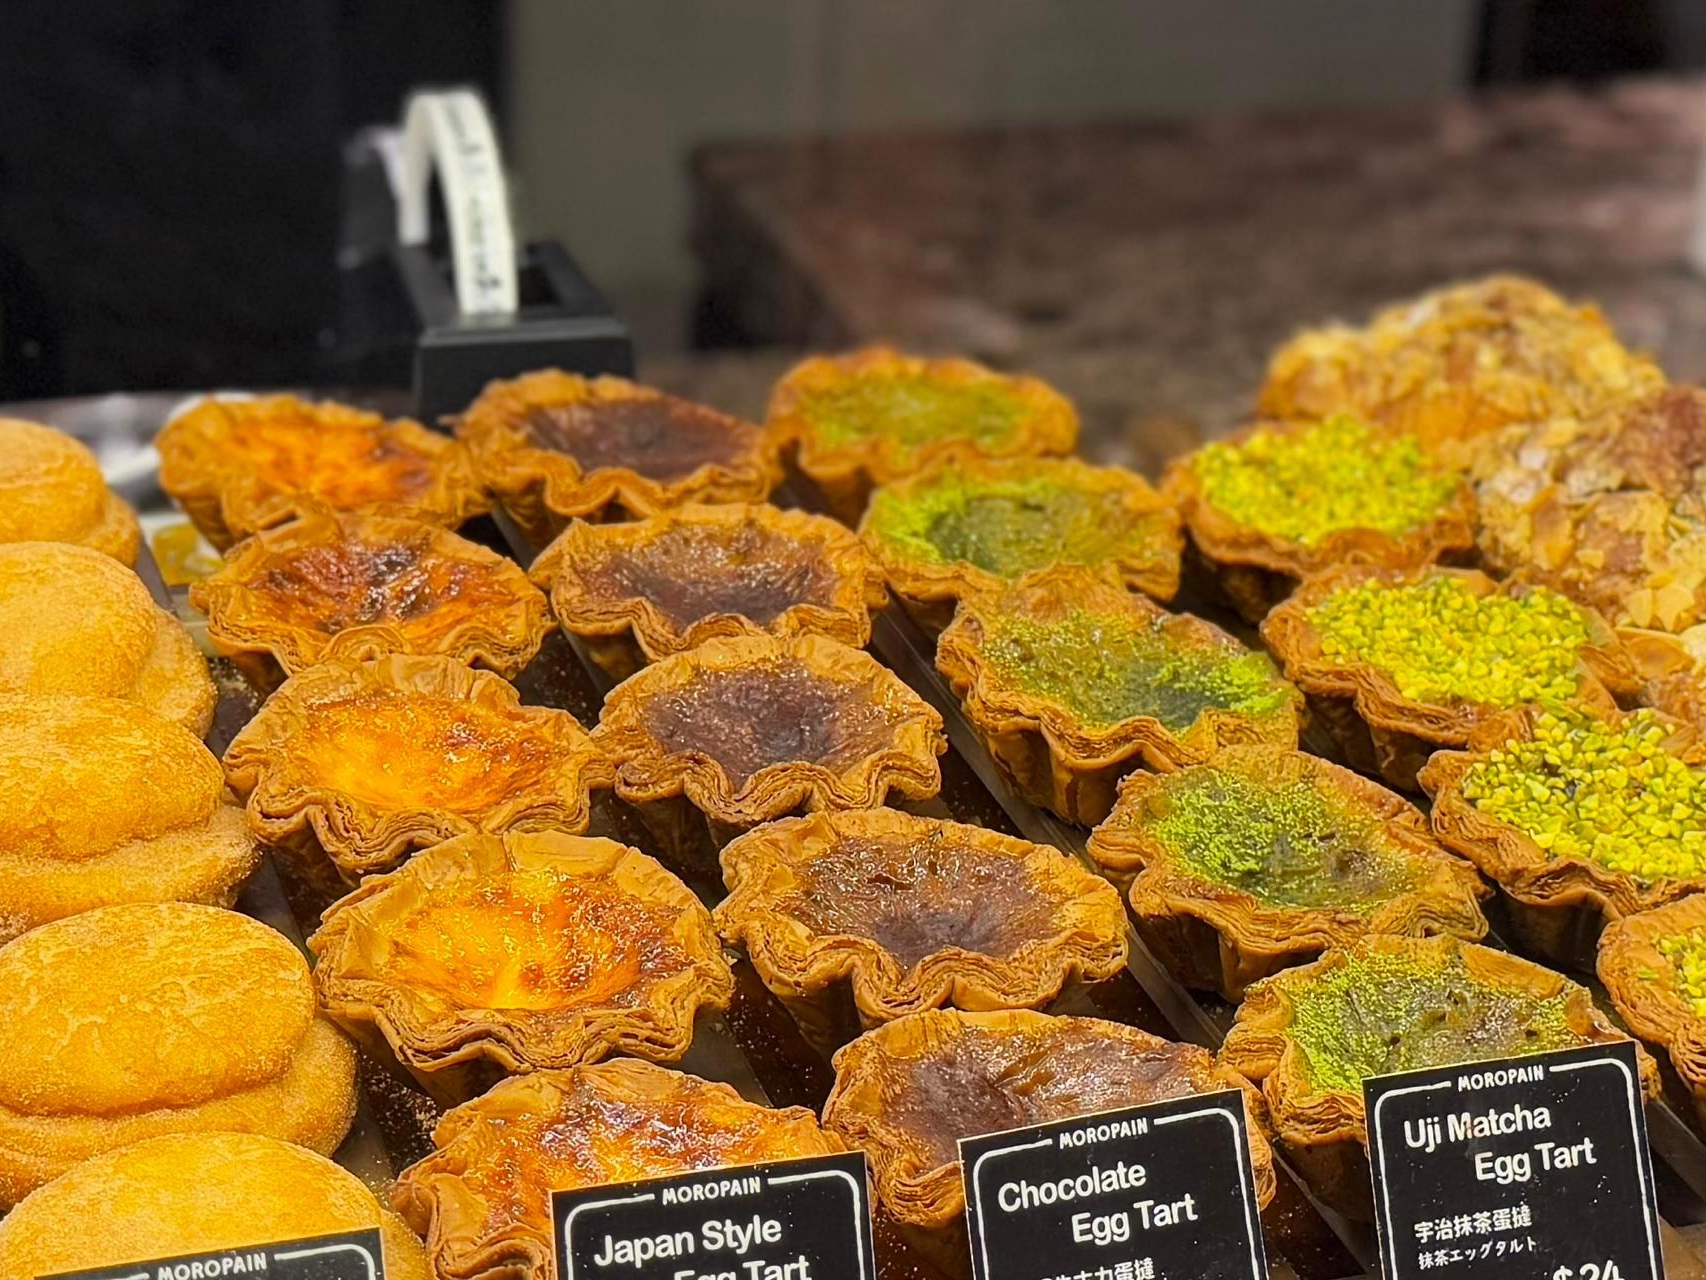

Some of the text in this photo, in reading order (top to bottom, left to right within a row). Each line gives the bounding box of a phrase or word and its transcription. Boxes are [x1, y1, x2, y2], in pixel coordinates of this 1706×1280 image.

[1457, 1065, 1544, 1092] MOROPAIN
[1059, 1118, 1148, 1149] MOROPAIN
[1404, 1104, 1551, 1153] Uji Matcha
[1475, 1136, 1597, 1185] Egg Tart
[662, 1177, 761, 1205] MOROPAIN
[998, 1161, 1147, 1212] Chocolate
[1072, 1193, 1198, 1245] Egg Tart
[1414, 1205, 1532, 1243] 宇治抹茶蛋撻
[594, 1214, 782, 1268] Japan Style
[1418, 1238, 1537, 1269] 抹茶エッグタルト
